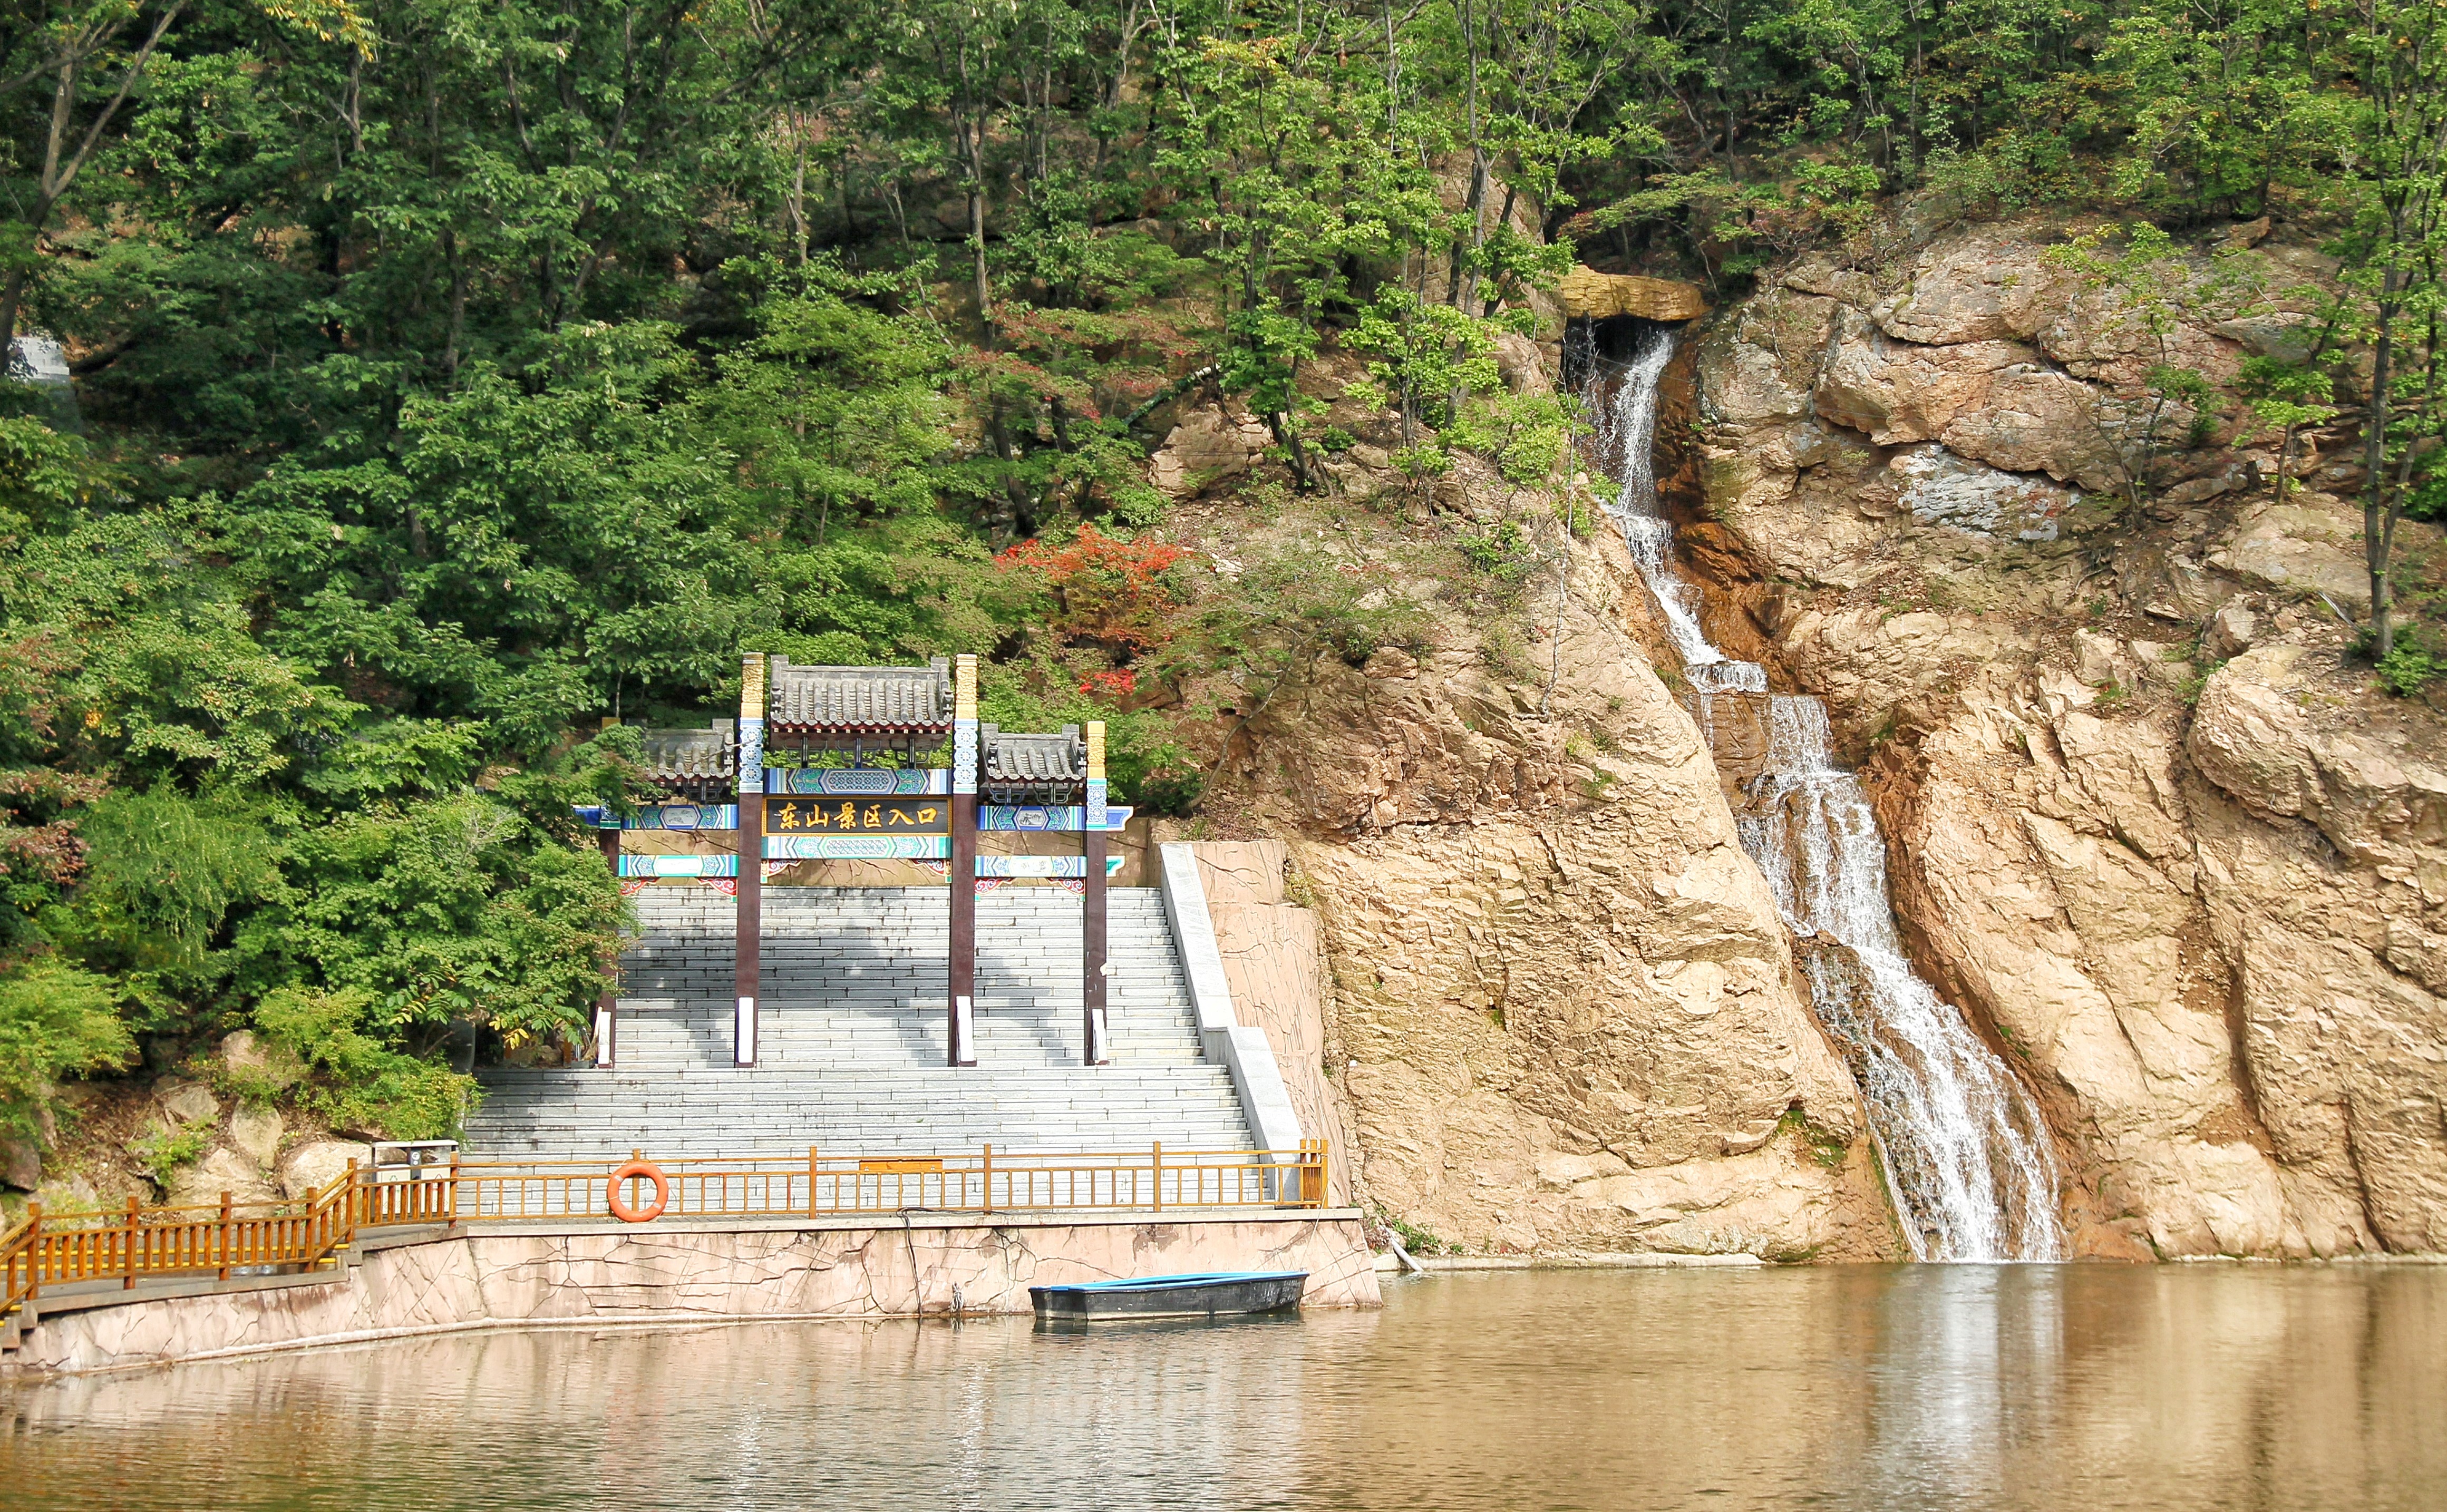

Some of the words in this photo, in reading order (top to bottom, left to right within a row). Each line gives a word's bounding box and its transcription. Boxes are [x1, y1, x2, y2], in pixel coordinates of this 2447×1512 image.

[779, 802, 938, 830] 东山景区入口
